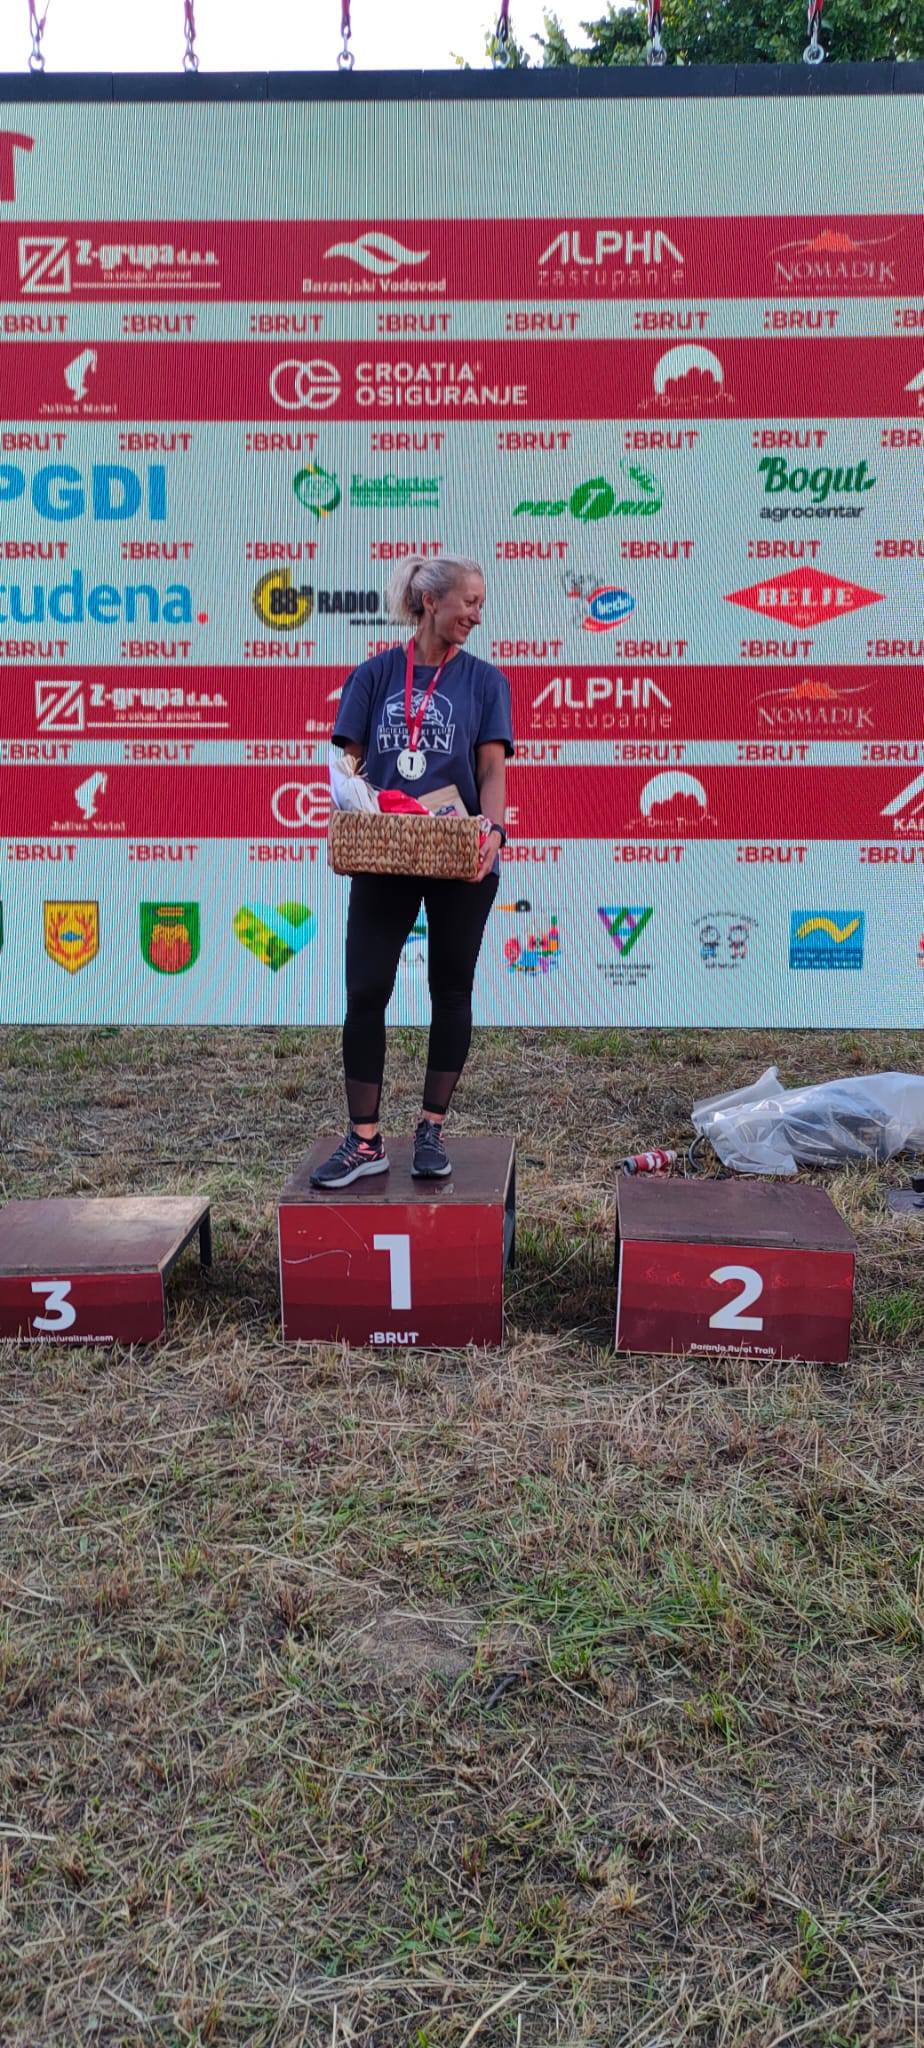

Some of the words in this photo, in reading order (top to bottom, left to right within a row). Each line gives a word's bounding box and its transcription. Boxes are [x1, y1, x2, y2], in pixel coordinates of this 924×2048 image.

[538, 231, 684, 265] ALPHA
[538, 268, 684, 292] zastupanje
[773, 260, 896, 283] NOMADIK
[379, 278, 447, 293] Vodovod
[0, 314, 68, 333] BRUT
[122, 314, 195, 333] :BRUT
[250, 314, 323, 333] :BRUT
[377, 313, 452, 333] :BRUT
[505, 312, 580, 331] :BRUT
[633, 311, 710, 330] :BRUT
[763, 310, 839, 329] :BRUT
[355, 363, 475, 383] CROATIA
[355, 386, 528, 406] OSIGURANJE
[2, 433, 67, 451] BRUT
[118, 433, 192, 451] :BRUT
[245, 432, 319, 451] :BRUT
[371, 432, 445, 451] :BRUT
[497, 432, 571, 450] :BRUT
[624, 431, 699, 449] :BRUT
[752, 430, 828, 449] :BRUT
[880, 429, 924, 448] :BR
[758, 457, 876, 503] Bogut
[760, 506, 864, 522] agrocentar
[121, 542, 194, 560] :BRUT
[245, 542, 318, 560] :BRUT
[496, 541, 568, 559] :BRUT
[621, 541, 694, 559] :BRUT
[748, 540, 821, 558] :BRUT
[318, 590, 379, 613] RADIO
[757, 588, 854, 606] BELJE
[121, 641, 191, 658] :BRUT
[244, 640, 317, 657] :BRUT
[492, 640, 563, 658] :BRUT
[616, 640, 688, 657] :BRUT
[740, 640, 814, 657] :BRUT
[867, 640, 924, 657] :BRU
[532, 677, 672, 709] ALPHA
[531, 712, 672, 733] zastupanje
[757, 706, 874, 728] NOMADIK
[380, 734, 451, 749] TITAN
[2, 744, 72, 760] :BRUT
[124, 744, 195, 760] :BRUT
[246, 744, 317, 760] :BRUT
[514, 745, 561, 760] RUT
[614, 744, 686, 760] :BRUT
[737, 745, 809, 760] :BRUT
[862, 745, 924, 760] :BRU
[408, 757, 414, 771] 1
[8, 846, 76, 861] :BRUT
[128, 845, 198, 861] :BRUT
[249, 845, 319, 861] :BRUT
[501, 846, 562, 862] BRUT
[614, 846, 684, 862] :BRUT
[737, 847, 807, 862] :BRUT
[373, 1234, 411, 1309] 1
[31, 1281, 76, 1331] 3
[709, 1265, 763, 1331] 2
[369, 1332, 419, 1344] :BRUT
